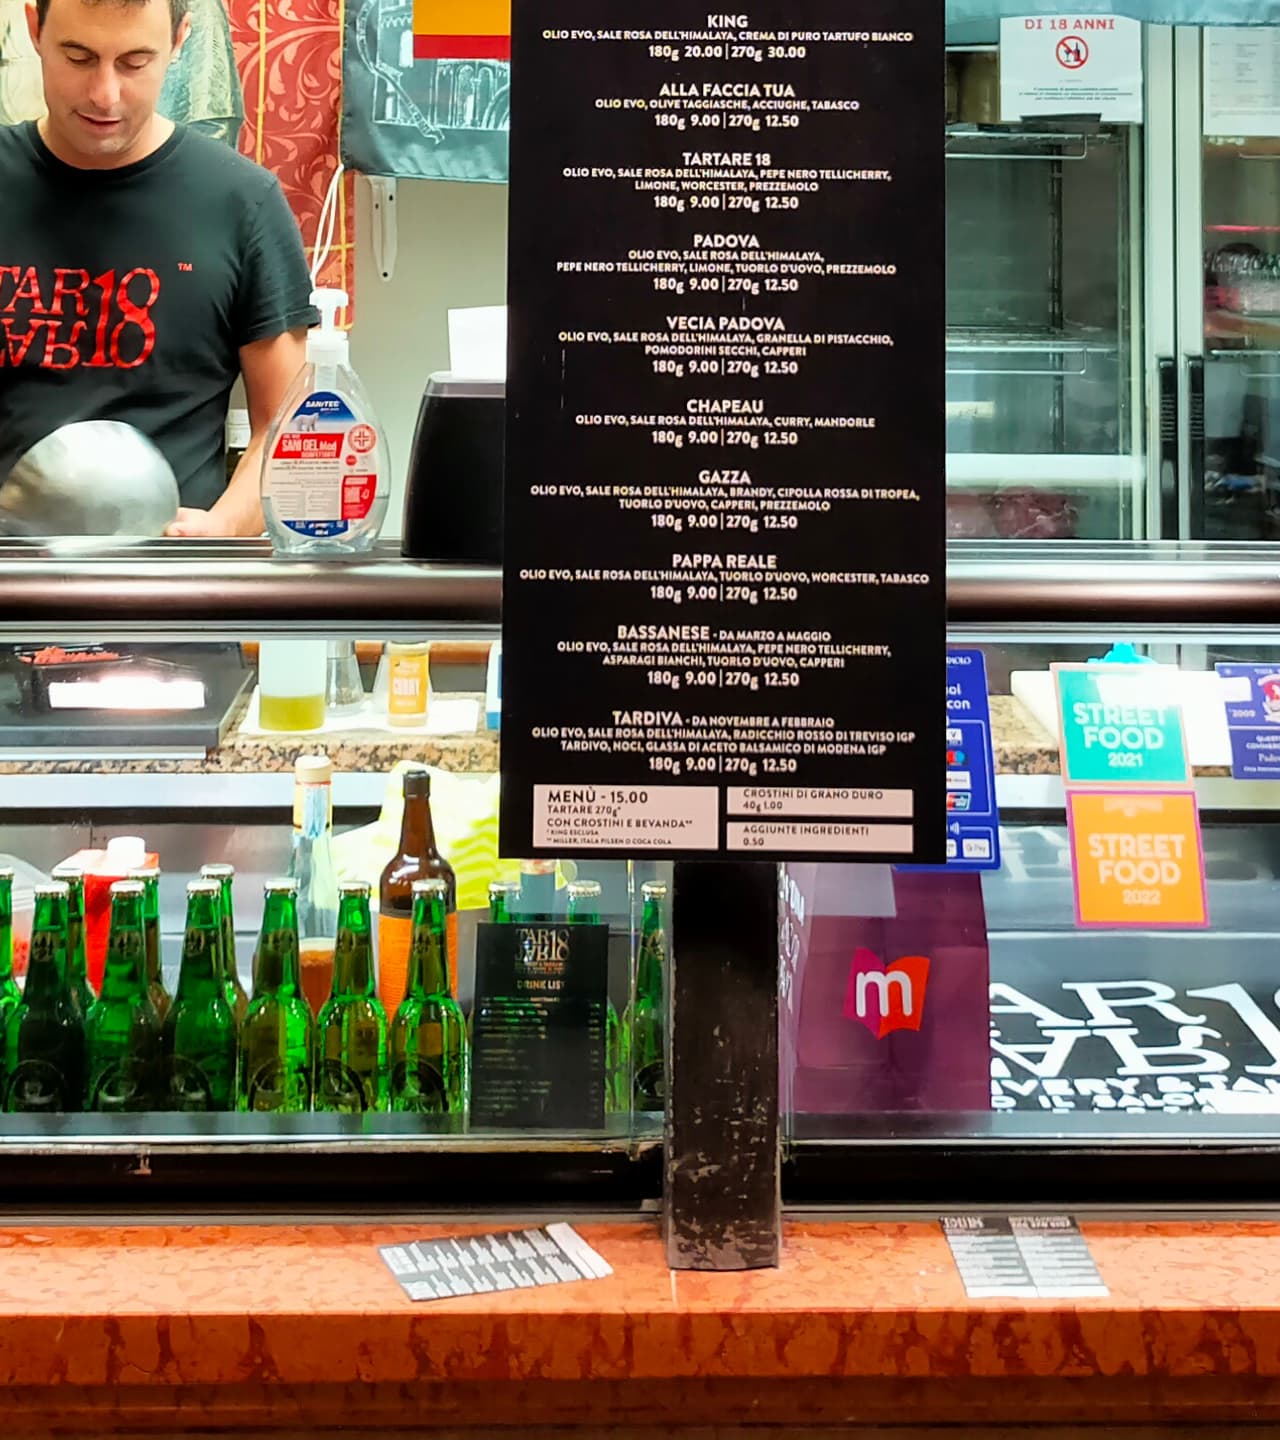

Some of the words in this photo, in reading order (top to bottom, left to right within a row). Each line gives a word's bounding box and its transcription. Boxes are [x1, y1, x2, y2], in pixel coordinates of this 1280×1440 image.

[707, 14, 749, 29] KING
[1024, 18, 1046, 31] DI
[1050, 19, 1069, 31] 18
[1073, 18, 1116, 31] ANNI
[648, 45, 680, 61] 180g
[684, 45, 723, 57] 20.00
[730, 46, 763, 63] 270g
[767, 46, 807, 58] 30.00
[659, 83, 700, 97] ALLA
[702, 83, 762, 98] FACCIA
[762, 84, 796, 97] TUA
[682, 152, 753, 167] TARTARE
[754, 153, 772, 166] 18
[693, 233, 761, 249] PADOVA
[666, 316, 716, 330] VECIA
[718, 316, 786, 331] PADOVA
[686, 398, 764, 414] CHAPEAU
[698, 469, 752, 485] GAZZA
[672, 553, 724, 568] PAPPA
[726, 554, 777, 569] REALE
[617, 625, 710, 640] BASSANESE
[612, 710, 684, 726] TARDIVA
[1073, 702, 1167, 726] STREET
[1083, 726, 1164, 750] FOOD
[1108, 752, 1143, 767] 2021
[547, 786, 596, 804] MENÙ
[610, 791, 648, 804] 15.00
[743, 789, 794, 800] CROSTINI
[797, 790, 808, 800] DI
[811, 790, 849, 800] GRANO
[851, 791, 883, 801] DURO
[547, 805, 593, 815] TARTARE
[547, 818, 571, 828] CON
[573, 819, 624, 828] CROSTINI
[743, 825, 797, 835] AGGIUNTE
[800, 826, 869, 836] INGREDIENTI
[1088, 833, 1185, 858] STREET
[1098, 860, 1181, 886] FOOD
[1123, 890, 1161, 905] 2022
